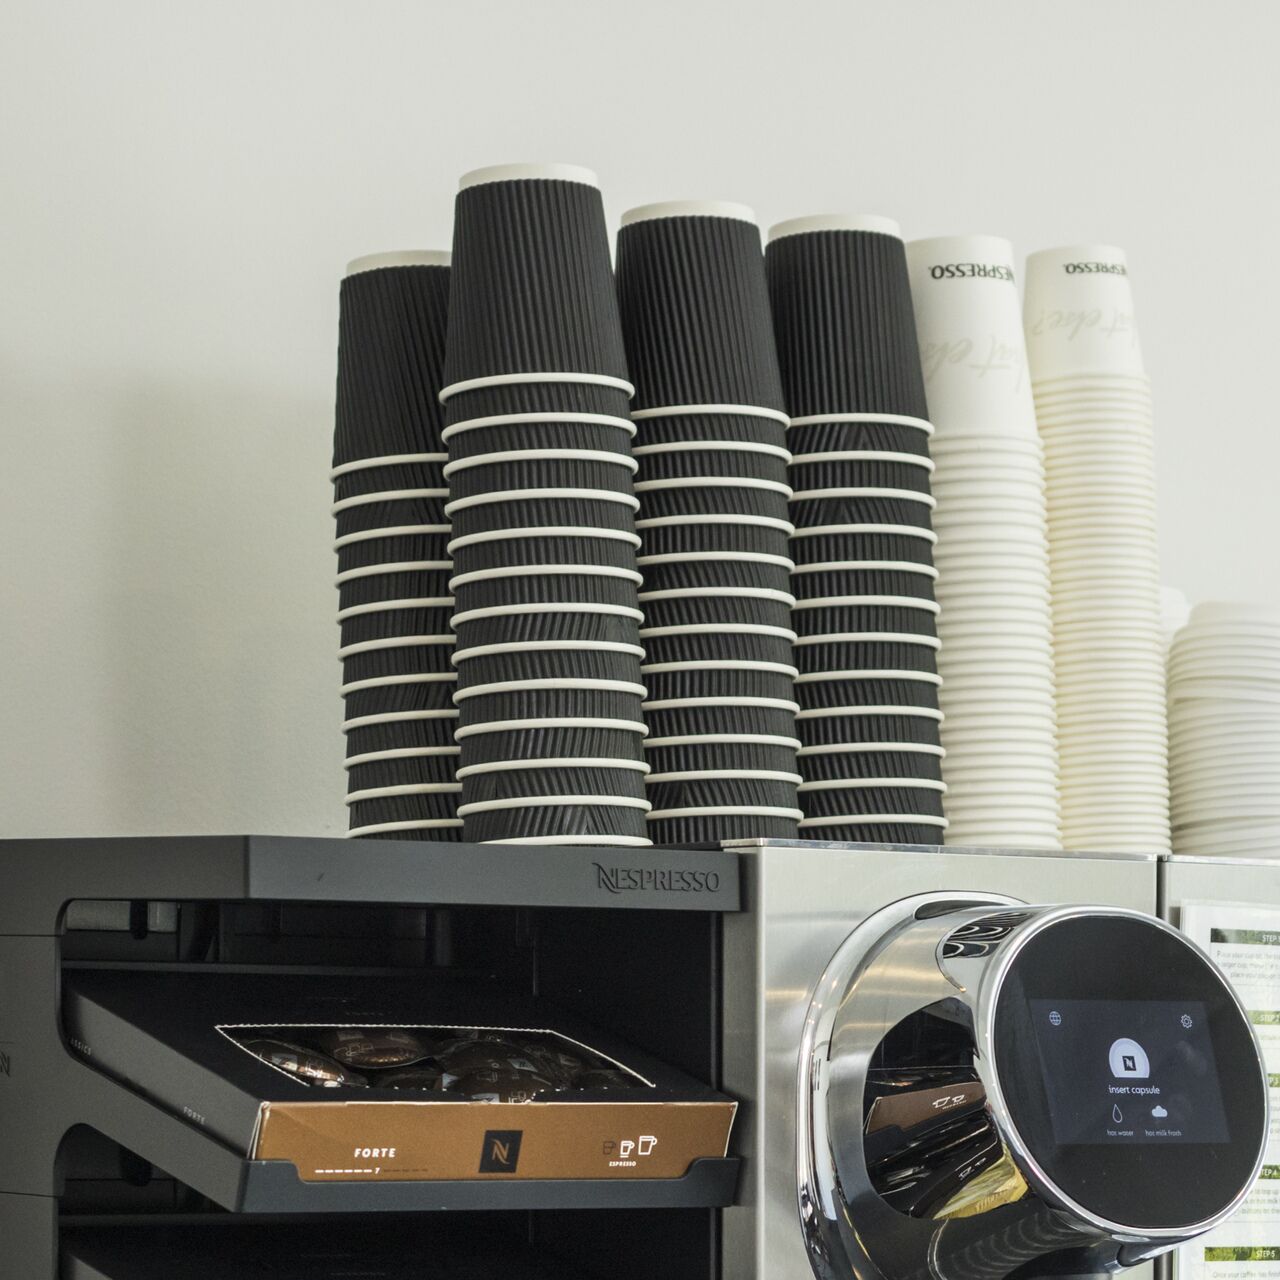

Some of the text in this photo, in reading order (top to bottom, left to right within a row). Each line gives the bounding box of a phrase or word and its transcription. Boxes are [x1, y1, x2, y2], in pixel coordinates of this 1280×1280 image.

[1065, 262, 1127, 275] ESPRESSO
[591, 862, 720, 894] NESPRESSO
[1108, 1084, 1161, 1097] insert capsule
[354, 1147, 396, 1158] FORTE
[1256, 1250, 1270, 1258] STEP
